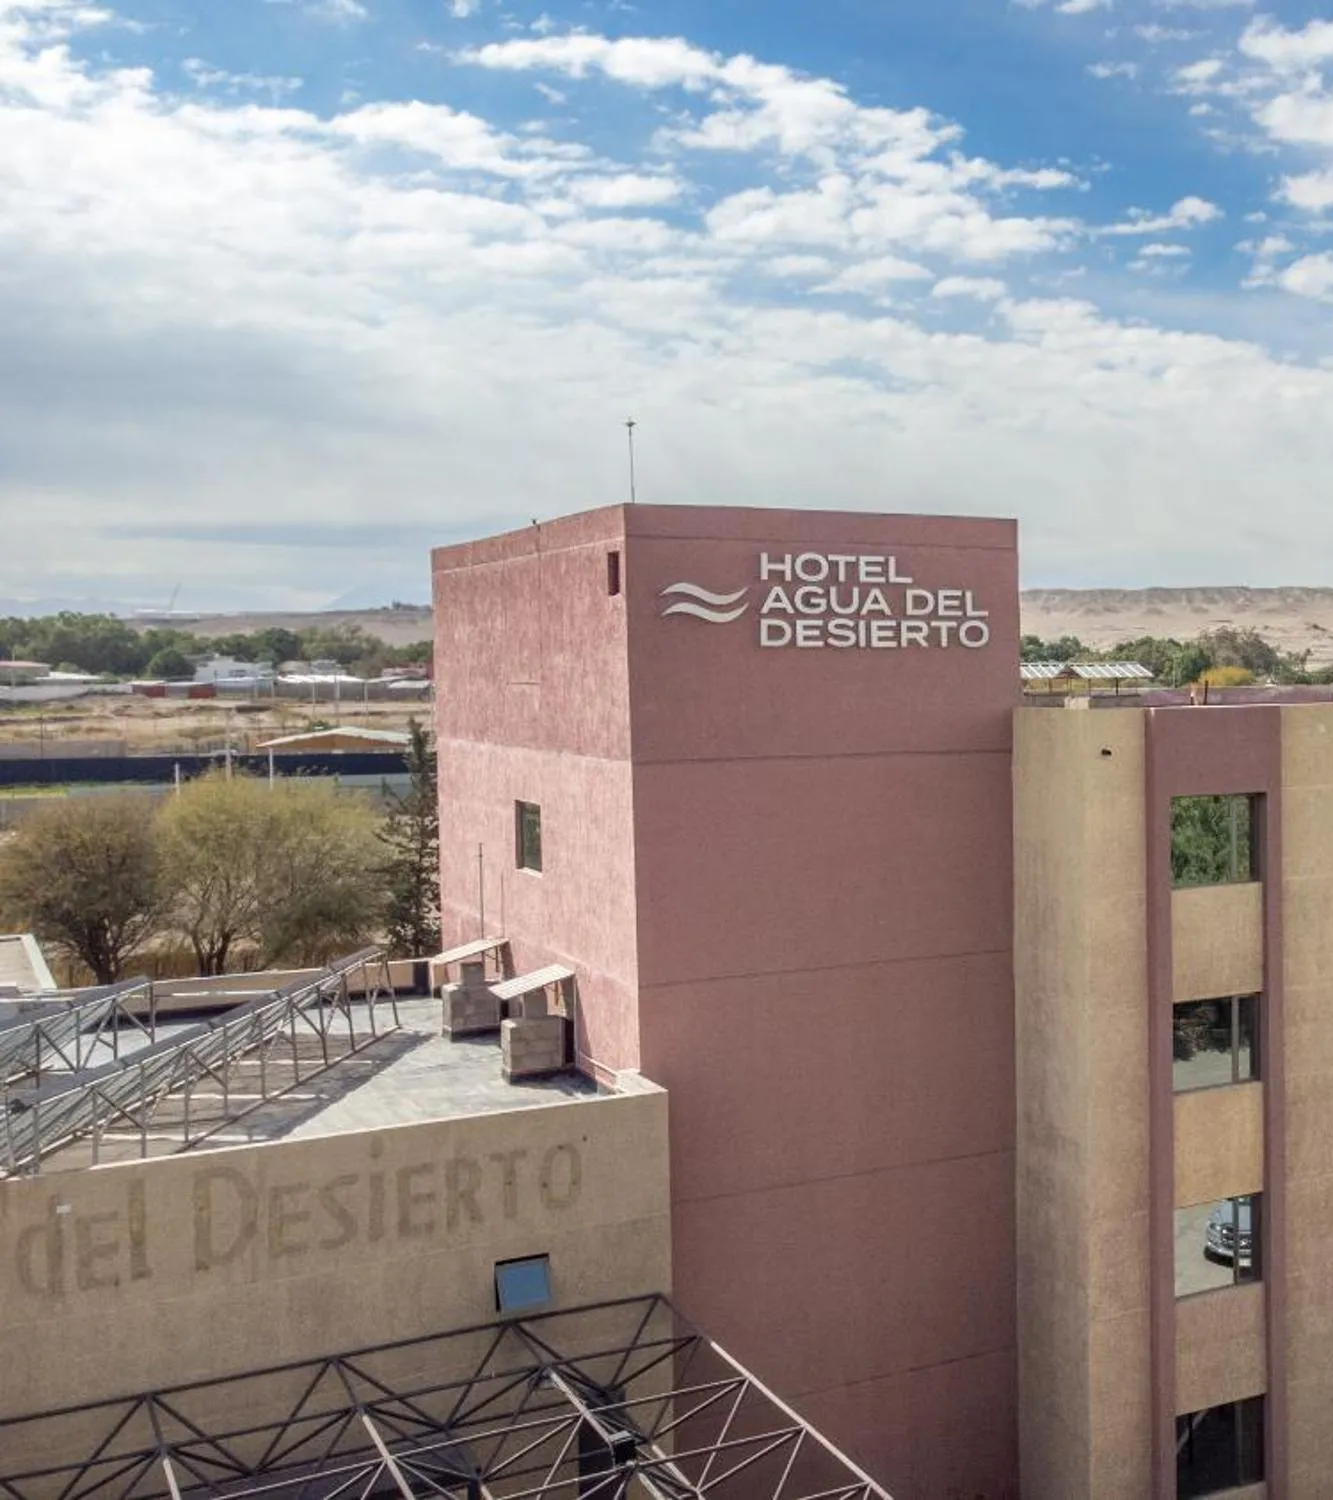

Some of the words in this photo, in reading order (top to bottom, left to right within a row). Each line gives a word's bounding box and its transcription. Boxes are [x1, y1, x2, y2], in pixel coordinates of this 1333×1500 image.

[760, 552, 913, 583] HOTEL
[760, 586, 892, 615] AGUA
[906, 589, 988, 617] DEL
[760, 619, 989, 648] DESIERTO
